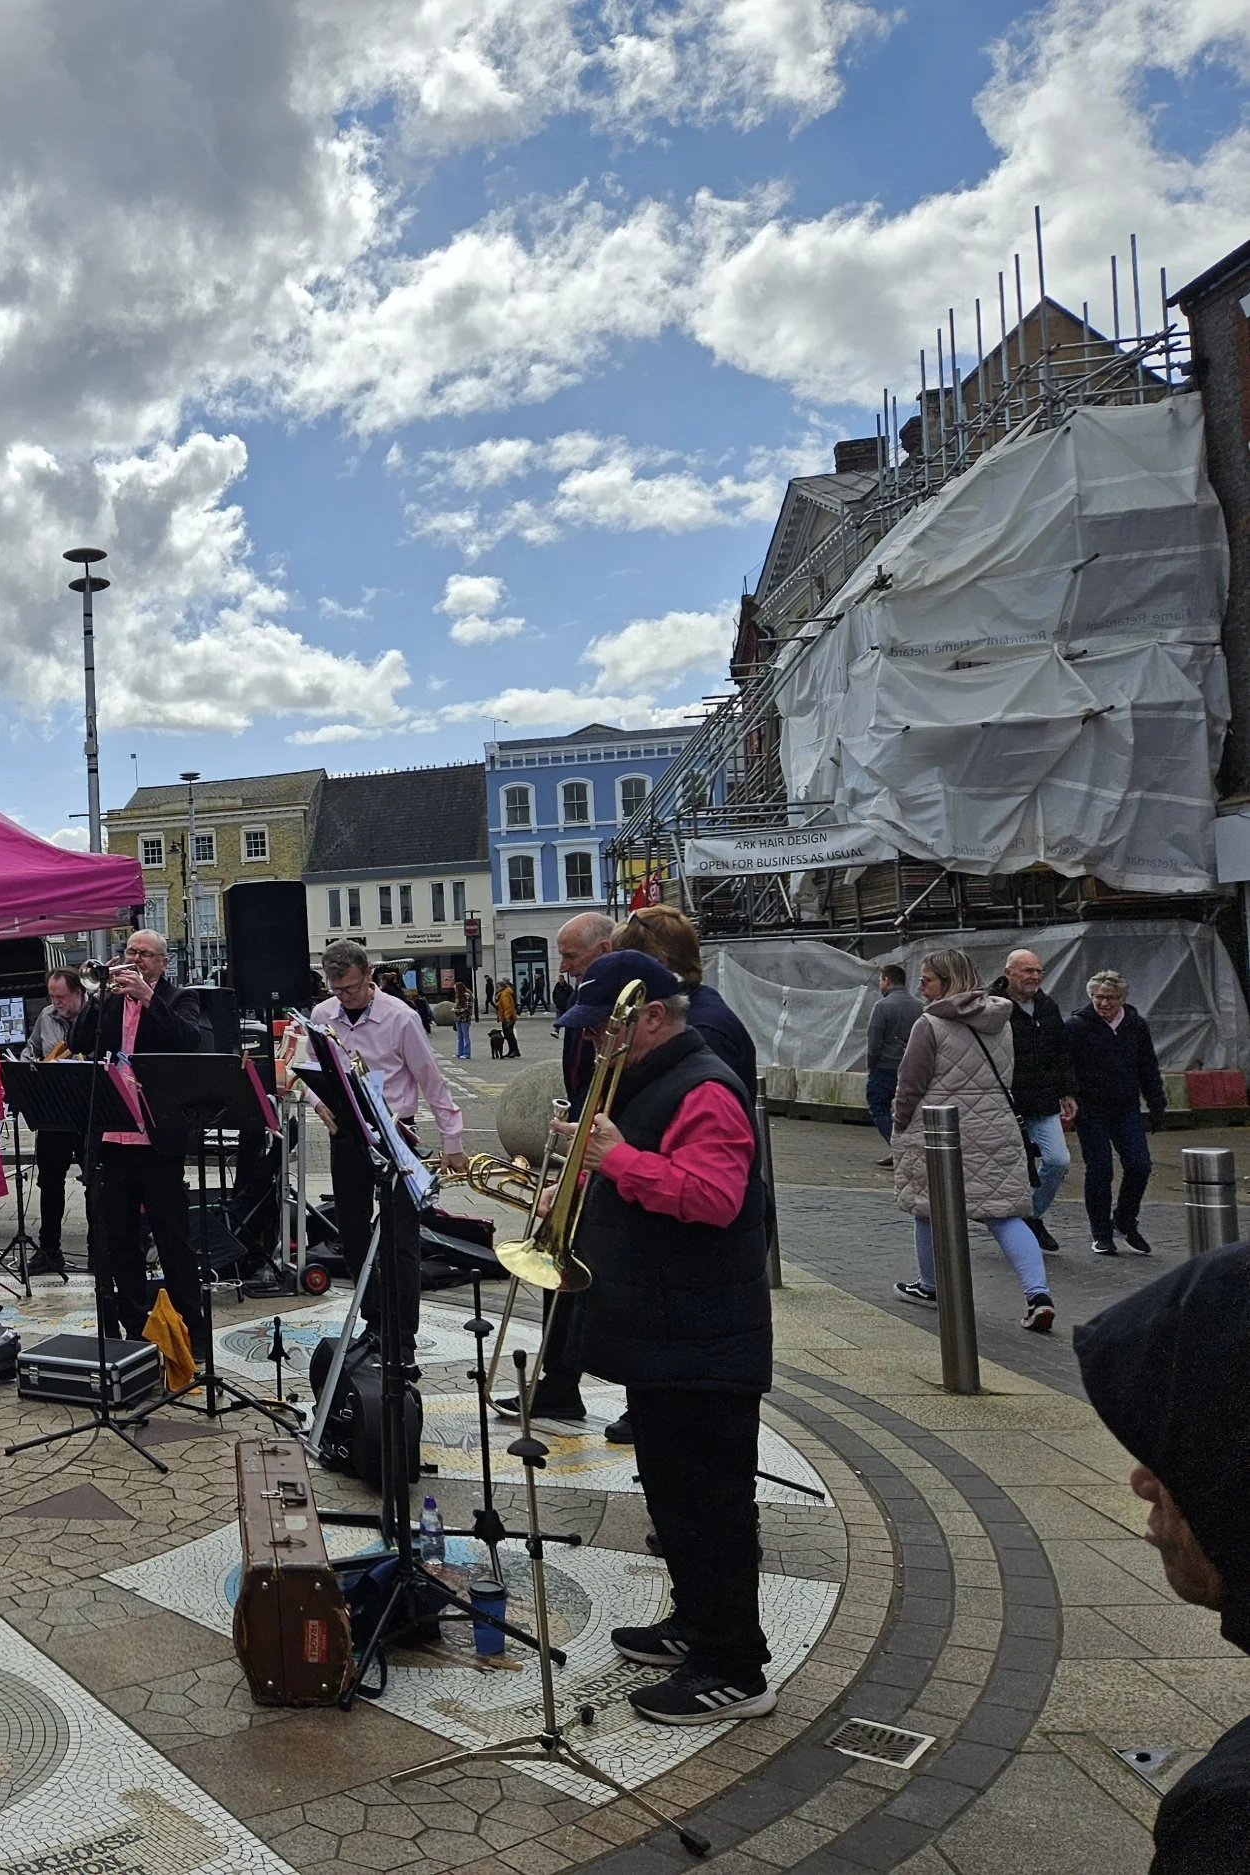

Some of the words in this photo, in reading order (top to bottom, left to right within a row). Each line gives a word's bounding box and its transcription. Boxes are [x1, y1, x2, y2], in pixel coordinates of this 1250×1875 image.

[734, 840, 756, 850] ARK
[759, 838, 785, 850] HAIR
[787, 833, 827, 847] DESIGN
[700, 860, 729, 871] OPEN
[732, 858, 753, 870] FOR
[757, 855, 808, 868] BUSINESS
[810, 852, 825, 863] AS
[826, 847, 866, 861] USUAL
